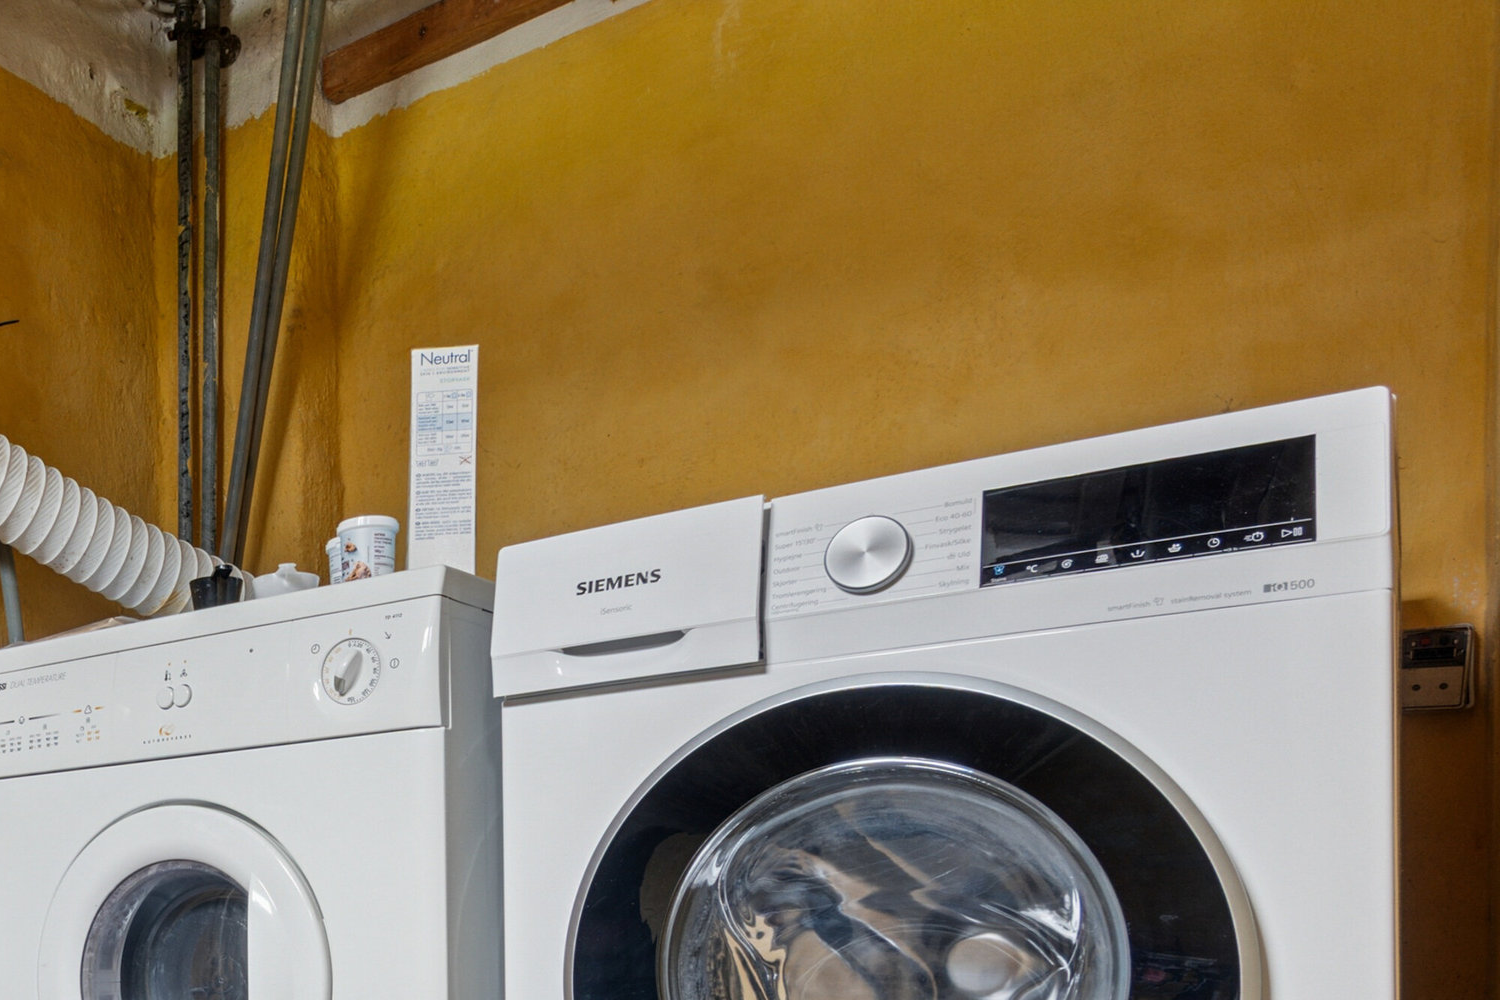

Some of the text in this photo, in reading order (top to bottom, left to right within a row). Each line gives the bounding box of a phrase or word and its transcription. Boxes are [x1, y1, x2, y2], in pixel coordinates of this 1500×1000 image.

[420, 349, 470, 366] Neutral
[576, 568, 662, 596] SIEMENS
[1224, 589, 1252, 600] system
